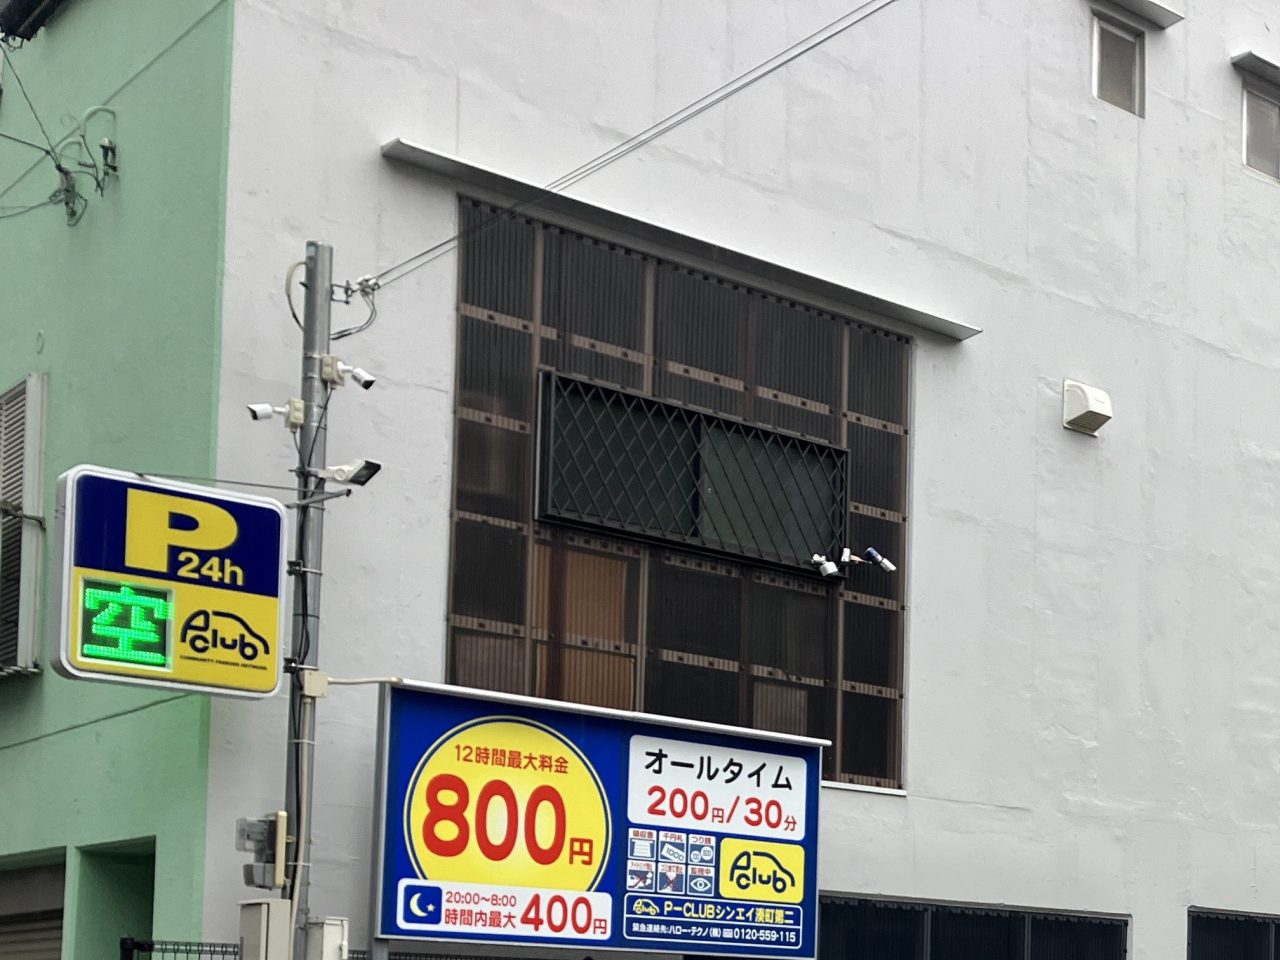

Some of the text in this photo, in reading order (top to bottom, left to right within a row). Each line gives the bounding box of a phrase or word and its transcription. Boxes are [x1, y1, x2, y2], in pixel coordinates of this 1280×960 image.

[124, 488, 239, 573] P
[177, 551, 244, 587] 24h
[83, 583, 170, 665] 空
[190, 629, 259, 661] club
[455, 744, 569, 774] 12時間最大料金
[645, 748, 792, 791] オールタイム
[422, 773, 594, 866] 800円
[647, 785, 797, 832] 200円/30分
[736, 868, 787, 894] club
[444, 908, 516, 929] 時間内最大
[520, 893, 608, 935] 400円
[733, 928, 796, 943] 0120-559-115
